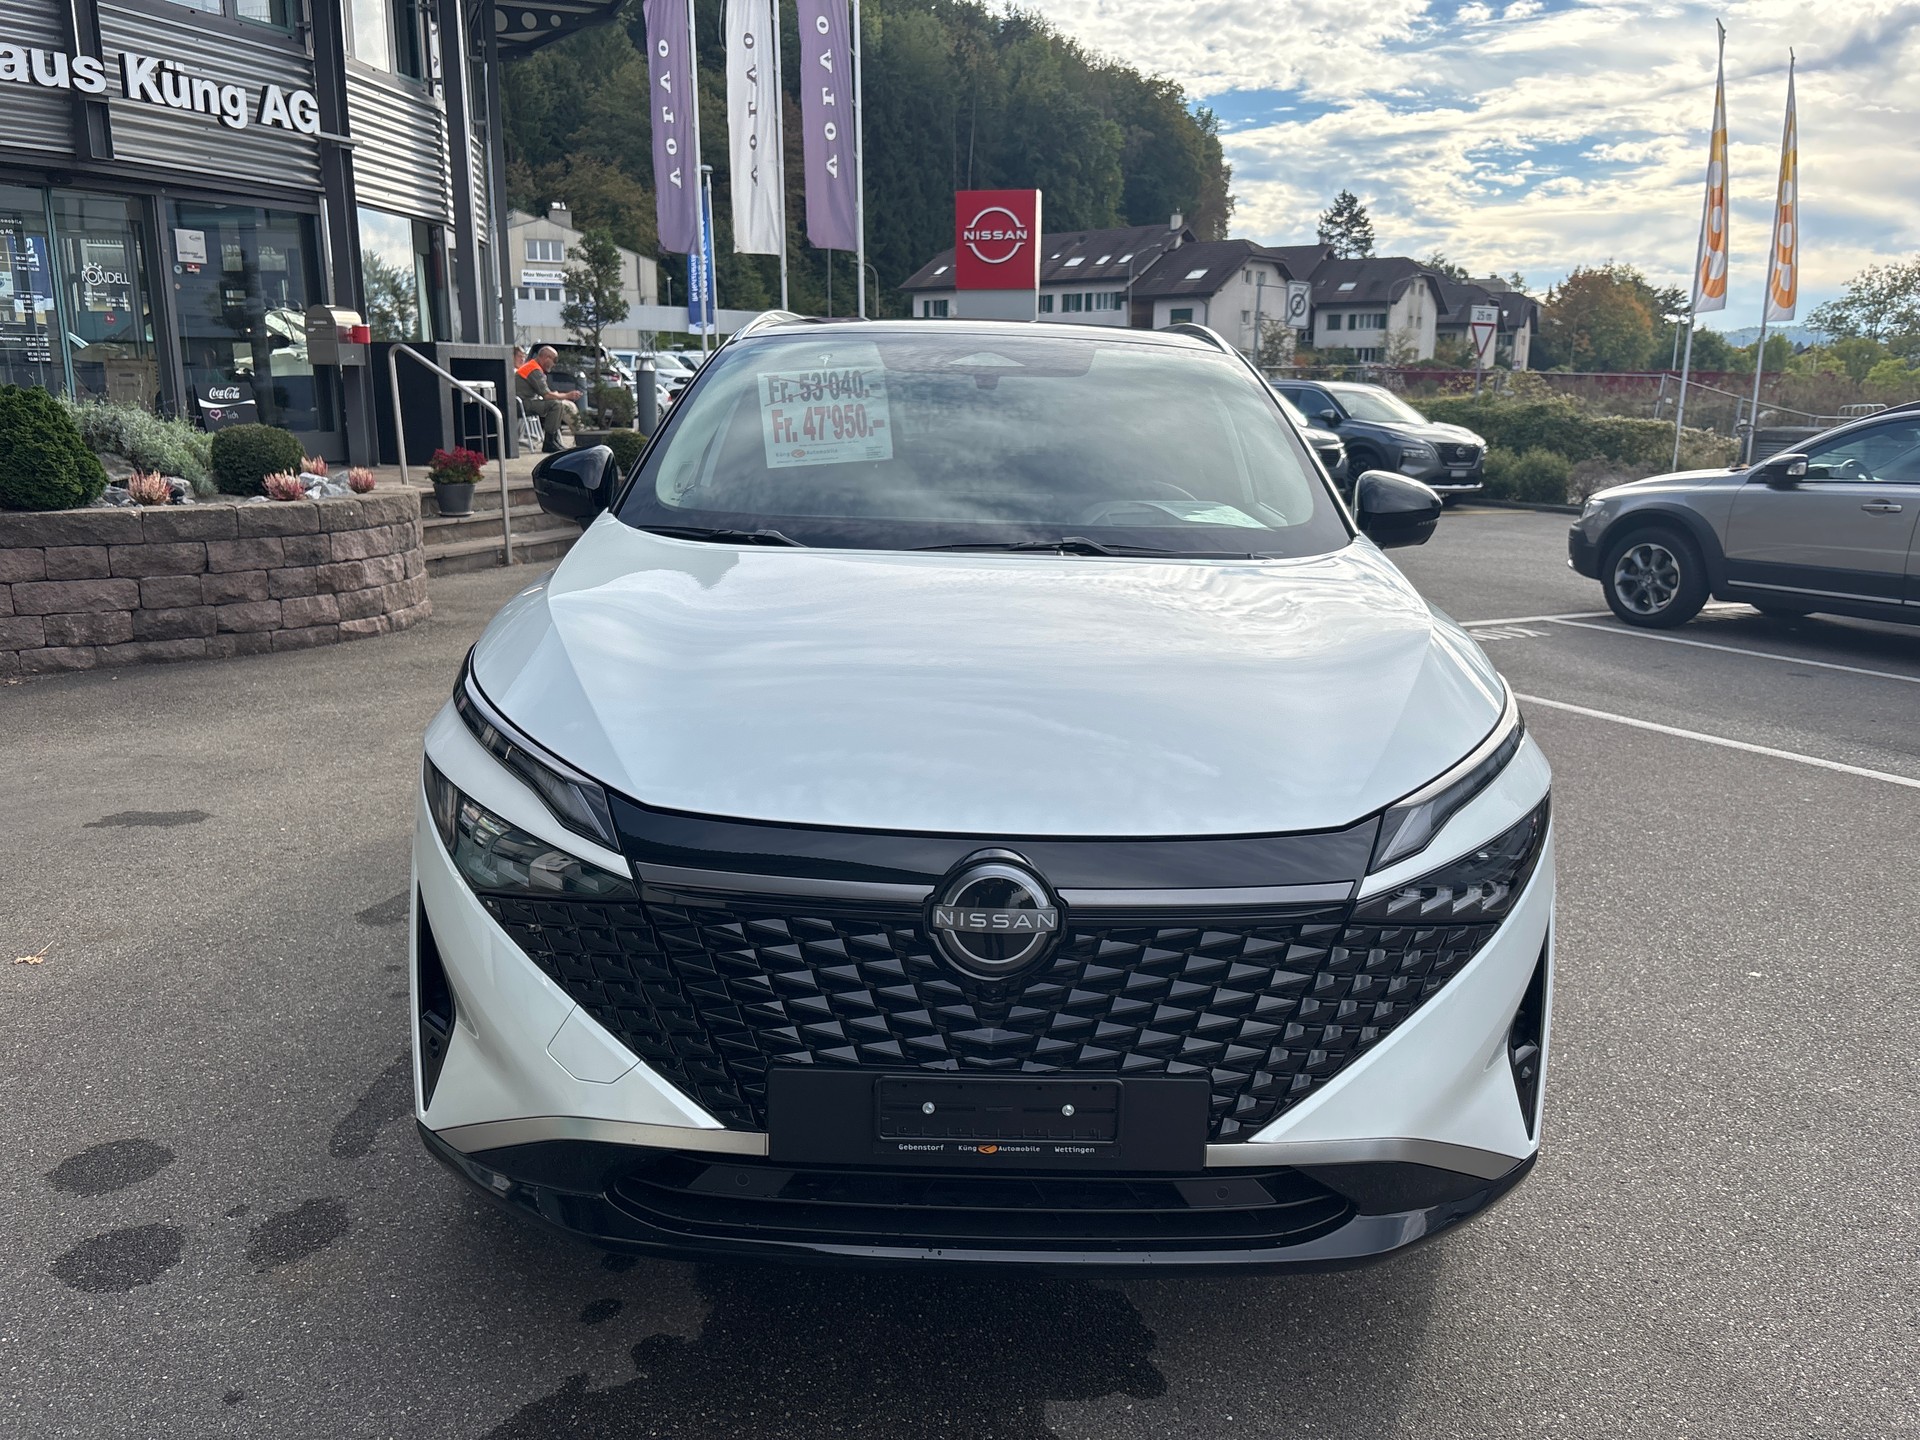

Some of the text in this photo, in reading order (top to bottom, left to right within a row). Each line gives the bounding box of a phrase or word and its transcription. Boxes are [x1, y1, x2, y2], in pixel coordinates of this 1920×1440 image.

[119, 51, 249, 130] Küng
[260, 84, 321, 135] AG
[963, 230, 1028, 241] NISSAN
[81, 270, 131, 285] RONDELL
[767, 375, 794, 404] Fr.
[771, 404, 885, 444] Fr. 47'950.-
[935, 909, 1056, 929] NISSAN
[898, 1143, 945, 1152] Gebenstorf
[958, 1144, 977, 1153] Küng
[1054, 1146, 1096, 1154] Wettingen
